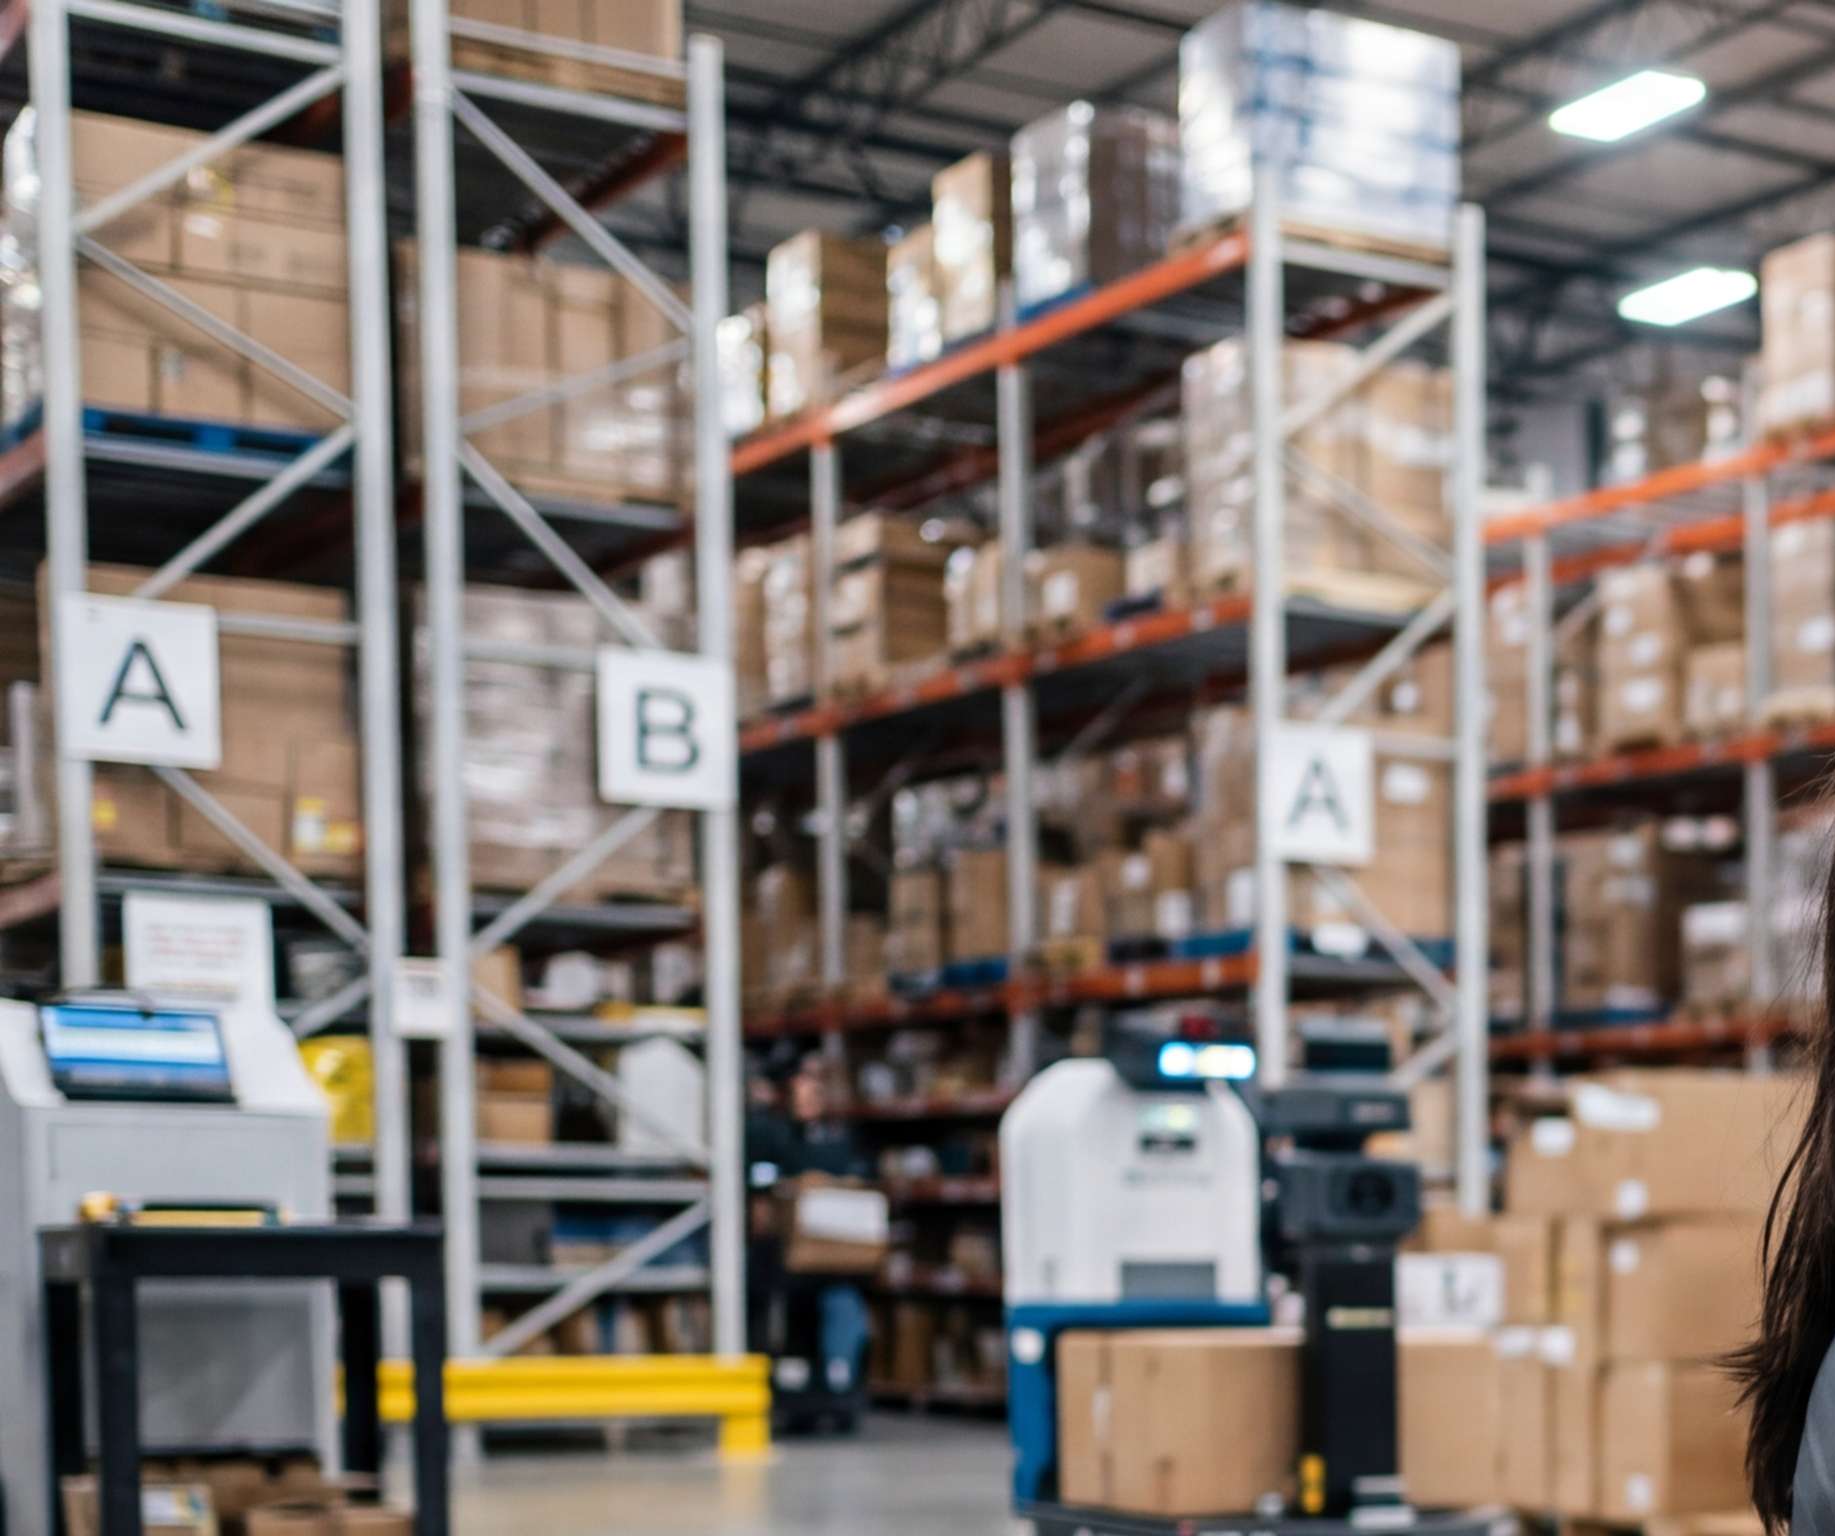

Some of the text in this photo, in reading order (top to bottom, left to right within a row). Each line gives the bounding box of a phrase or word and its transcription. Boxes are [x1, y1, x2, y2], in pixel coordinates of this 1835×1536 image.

[99, 639, 187, 731] A
[635, 688, 702, 775] B
[1286, 756, 1350, 832] A
